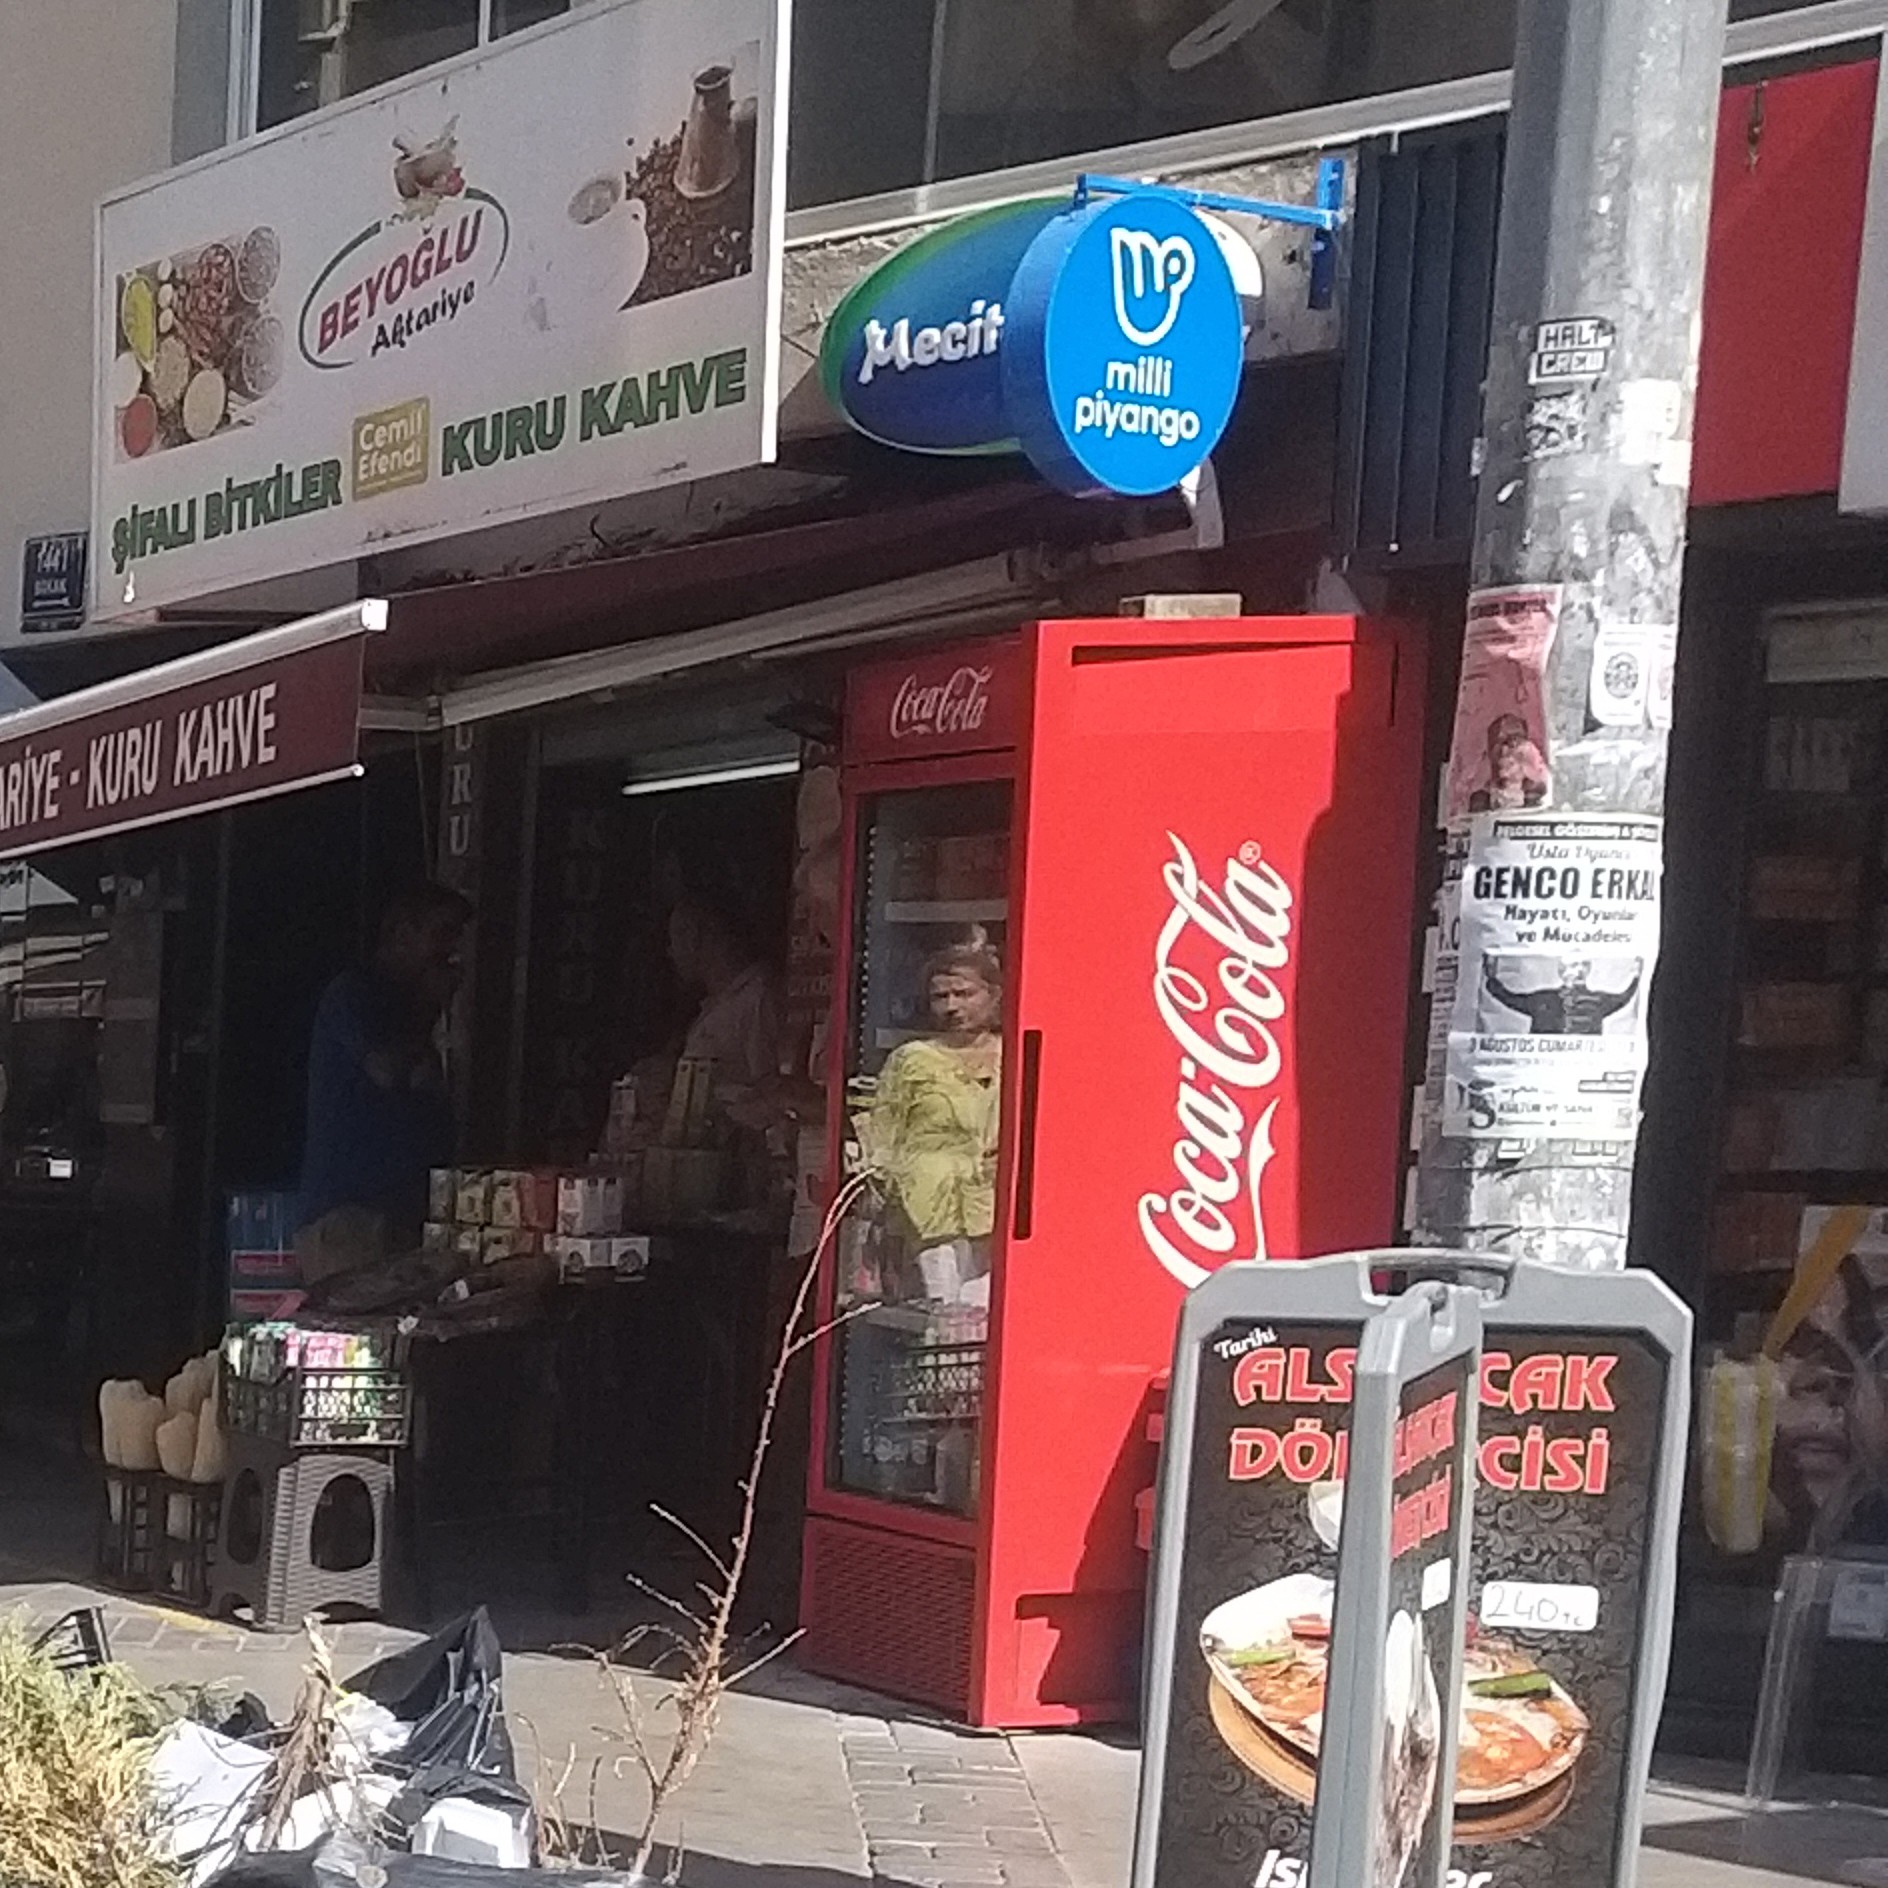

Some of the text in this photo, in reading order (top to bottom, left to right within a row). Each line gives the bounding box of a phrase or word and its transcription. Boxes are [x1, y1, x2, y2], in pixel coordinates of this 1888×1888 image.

[316, 208, 483, 355] BEYOĞLU
[857, 300, 1005, 384] Mecit
[1543, 324, 1599, 349] HALT
[1105, 355, 1173, 398] milli
[1074, 390, 1200, 447] piyango
[111, 348, 747, 573] ŞİFALI BİTKİLER KURU KAHVE
[358, 440, 422, 481] Efendi
[889, 665, 992, 740] Coca-Cola
[85, 719, 163, 810] KURU
[172, 681, 278, 787] KAHVE
[1473, 866, 1581, 900] GENCO
[1503, 904, 1571, 925] Hayatı,
[1138, 829, 1295, 1288] Coca-Cola
[1214, 1325, 1278, 1360] Tarihi
[1233, 1347, 1618, 1413] ALSCAK
[1228, 1417, 1610, 1495] DÖCİSİ
[1485, 1582, 1559, 1625] 240
